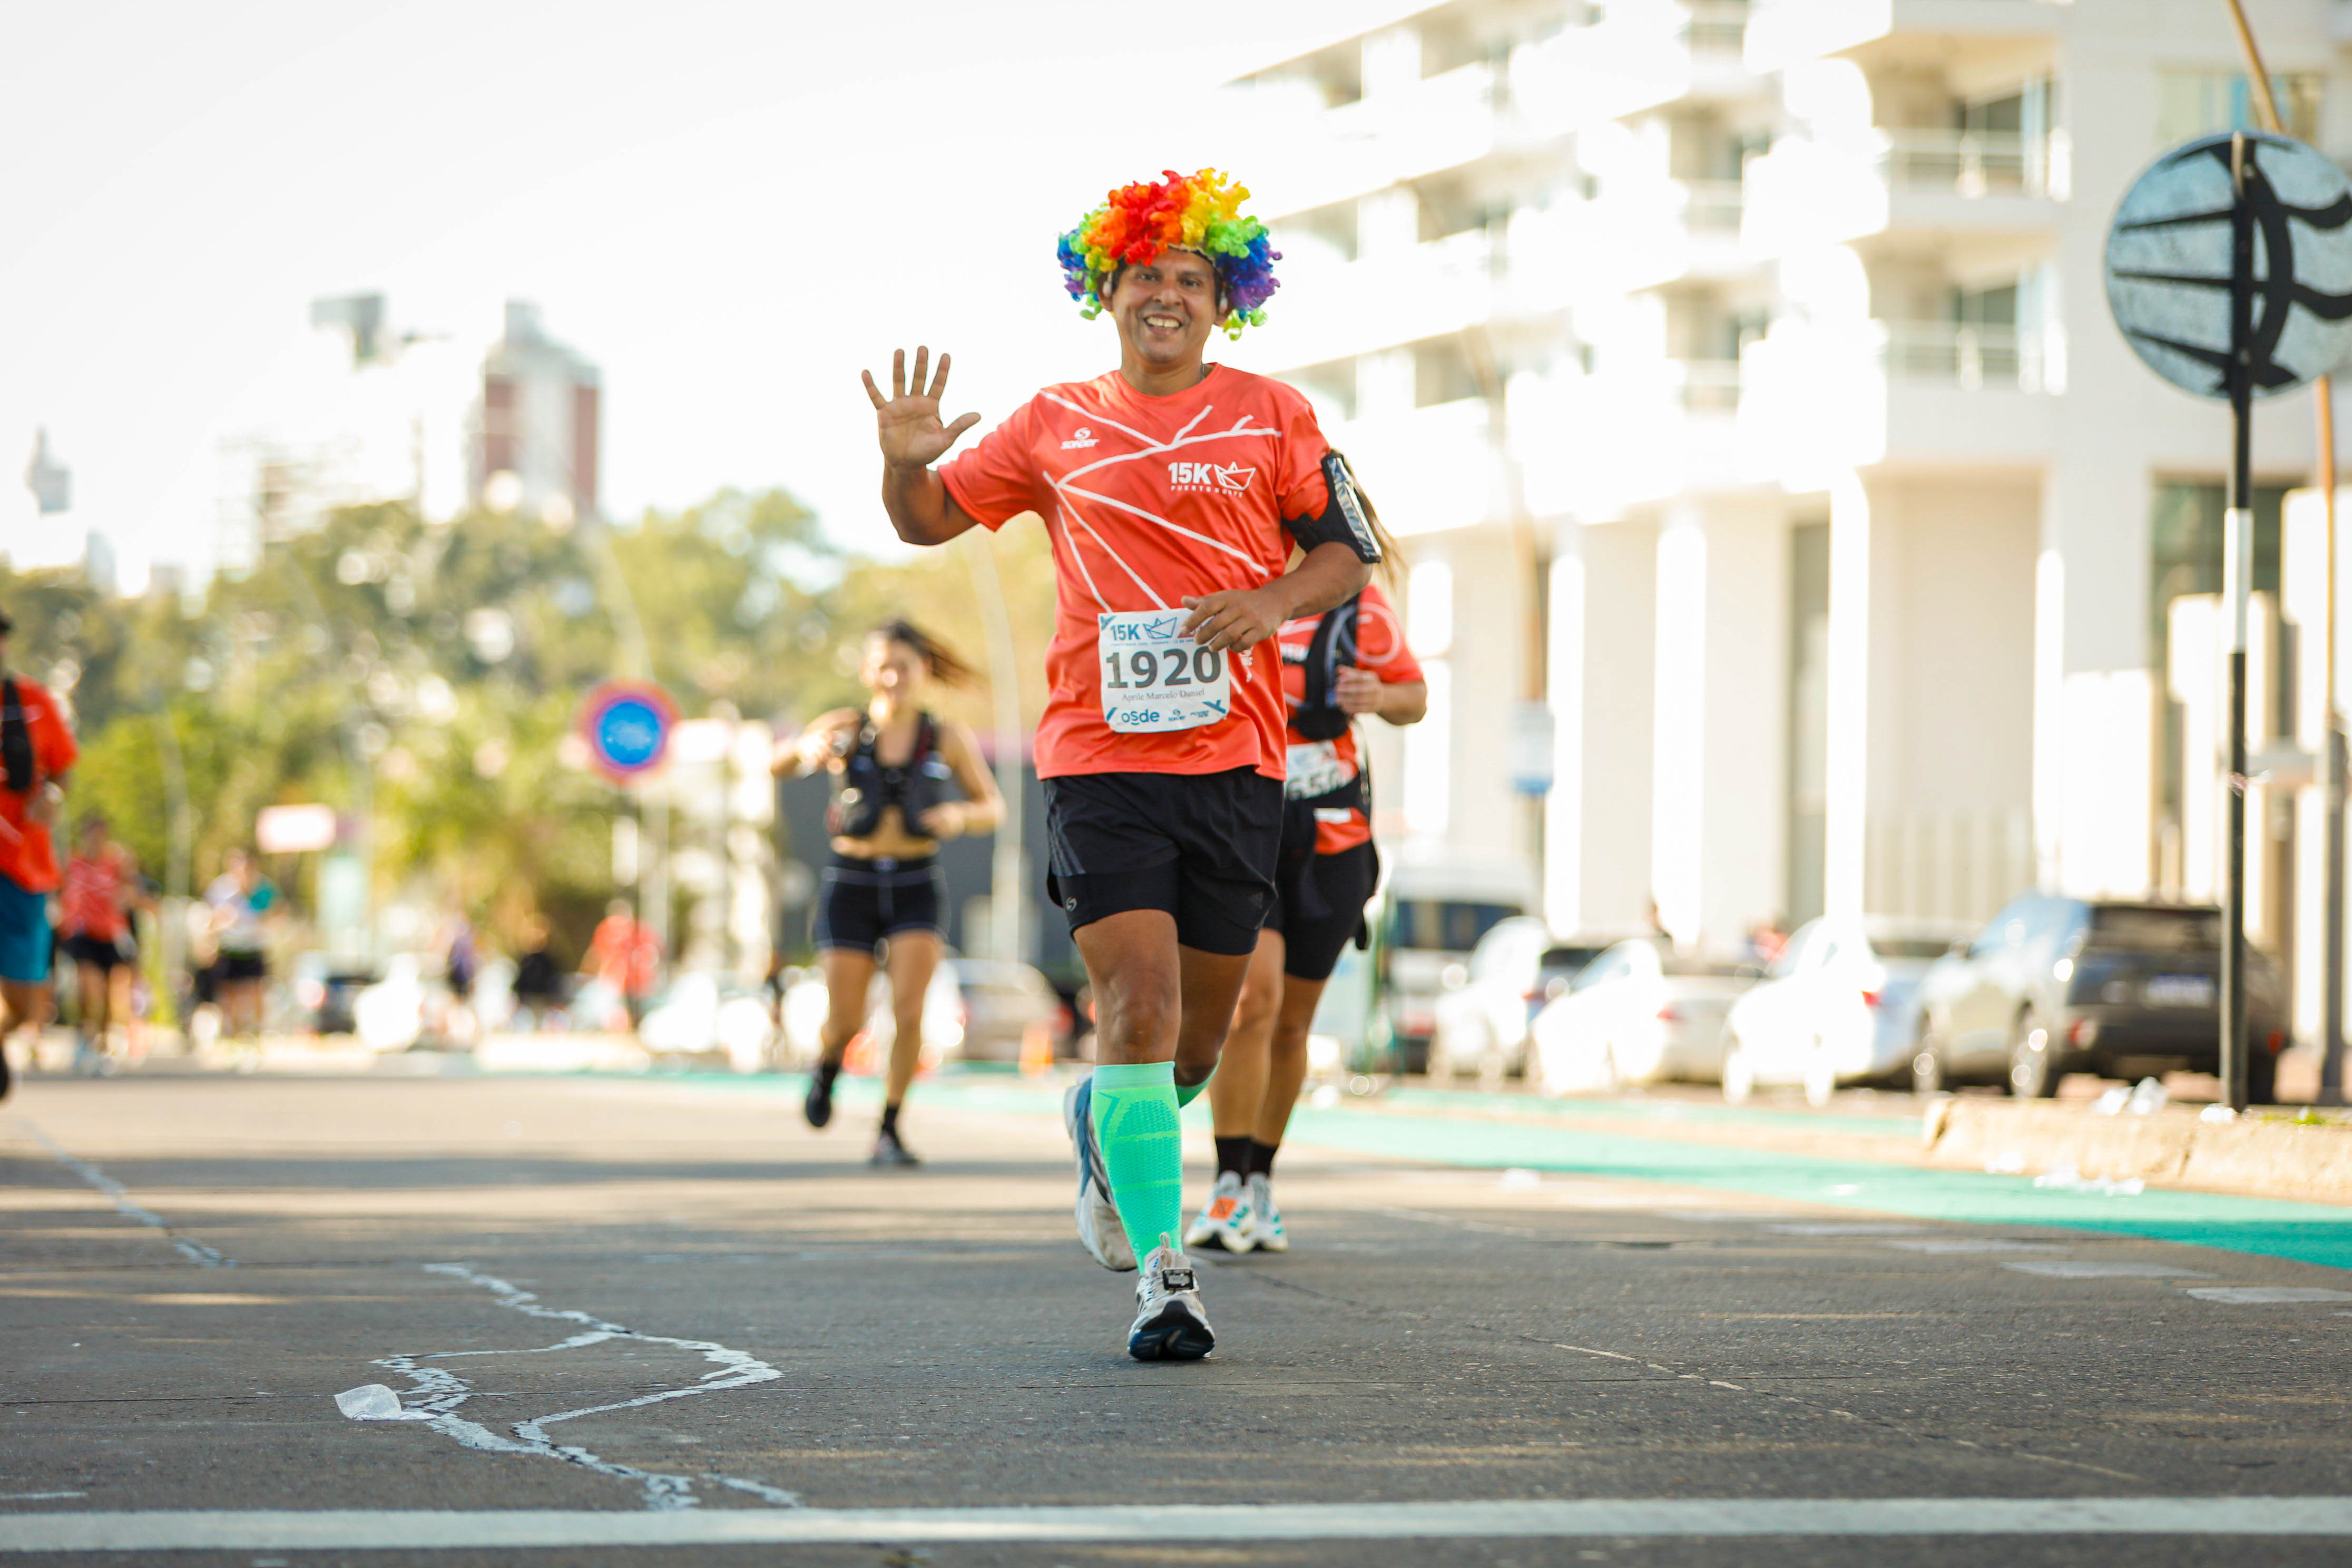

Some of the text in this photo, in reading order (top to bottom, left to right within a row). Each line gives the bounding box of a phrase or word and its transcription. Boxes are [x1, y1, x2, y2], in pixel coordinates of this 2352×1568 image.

[1168, 462, 1212, 485] 15K
[1110, 623, 1141, 641] 15K
[1106, 645, 1221, 688] 1920
[1146, 691, 1178, 700] Marcelo
[1121, 709, 1160, 724] osde
